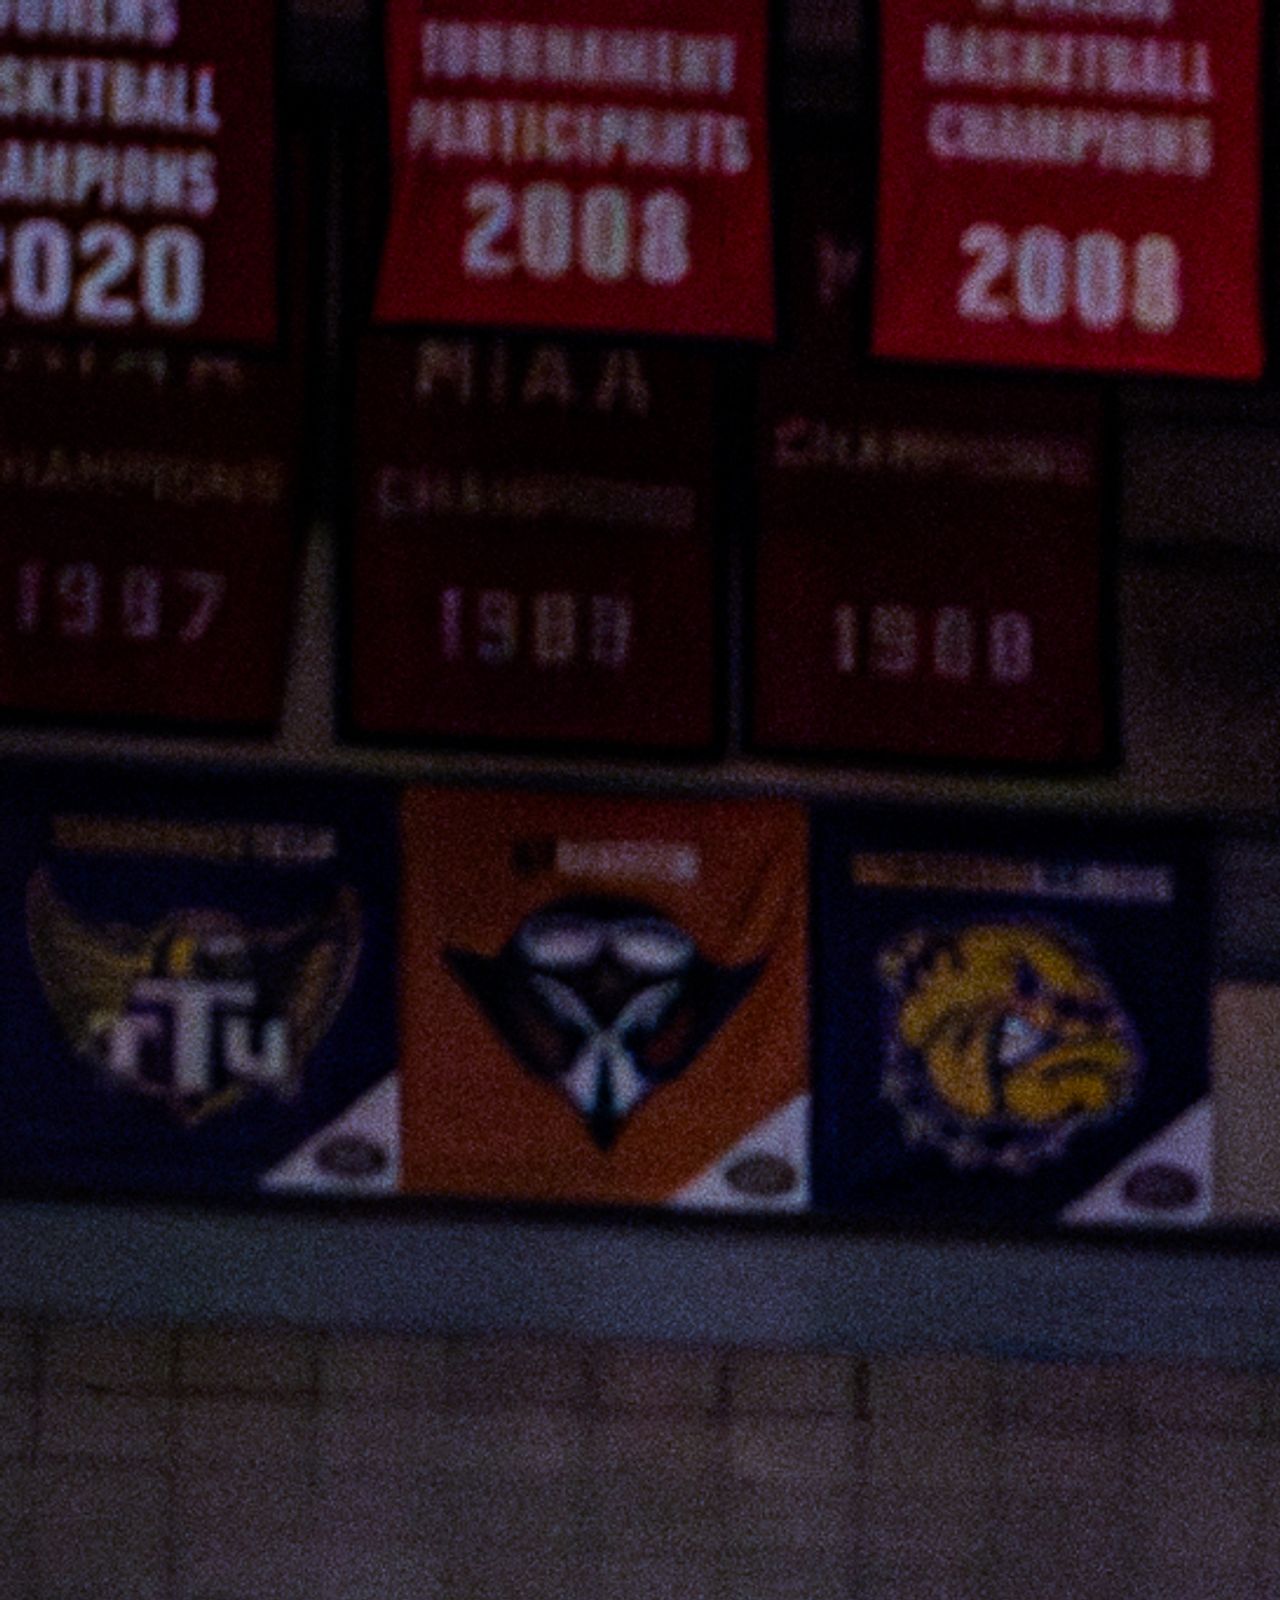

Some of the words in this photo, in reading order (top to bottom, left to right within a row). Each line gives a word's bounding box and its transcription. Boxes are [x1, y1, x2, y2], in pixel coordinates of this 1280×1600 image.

[0, 214, 206, 328] 020
[460, 178, 694, 288] 2008
[955, 220, 1184, 337] 2008
